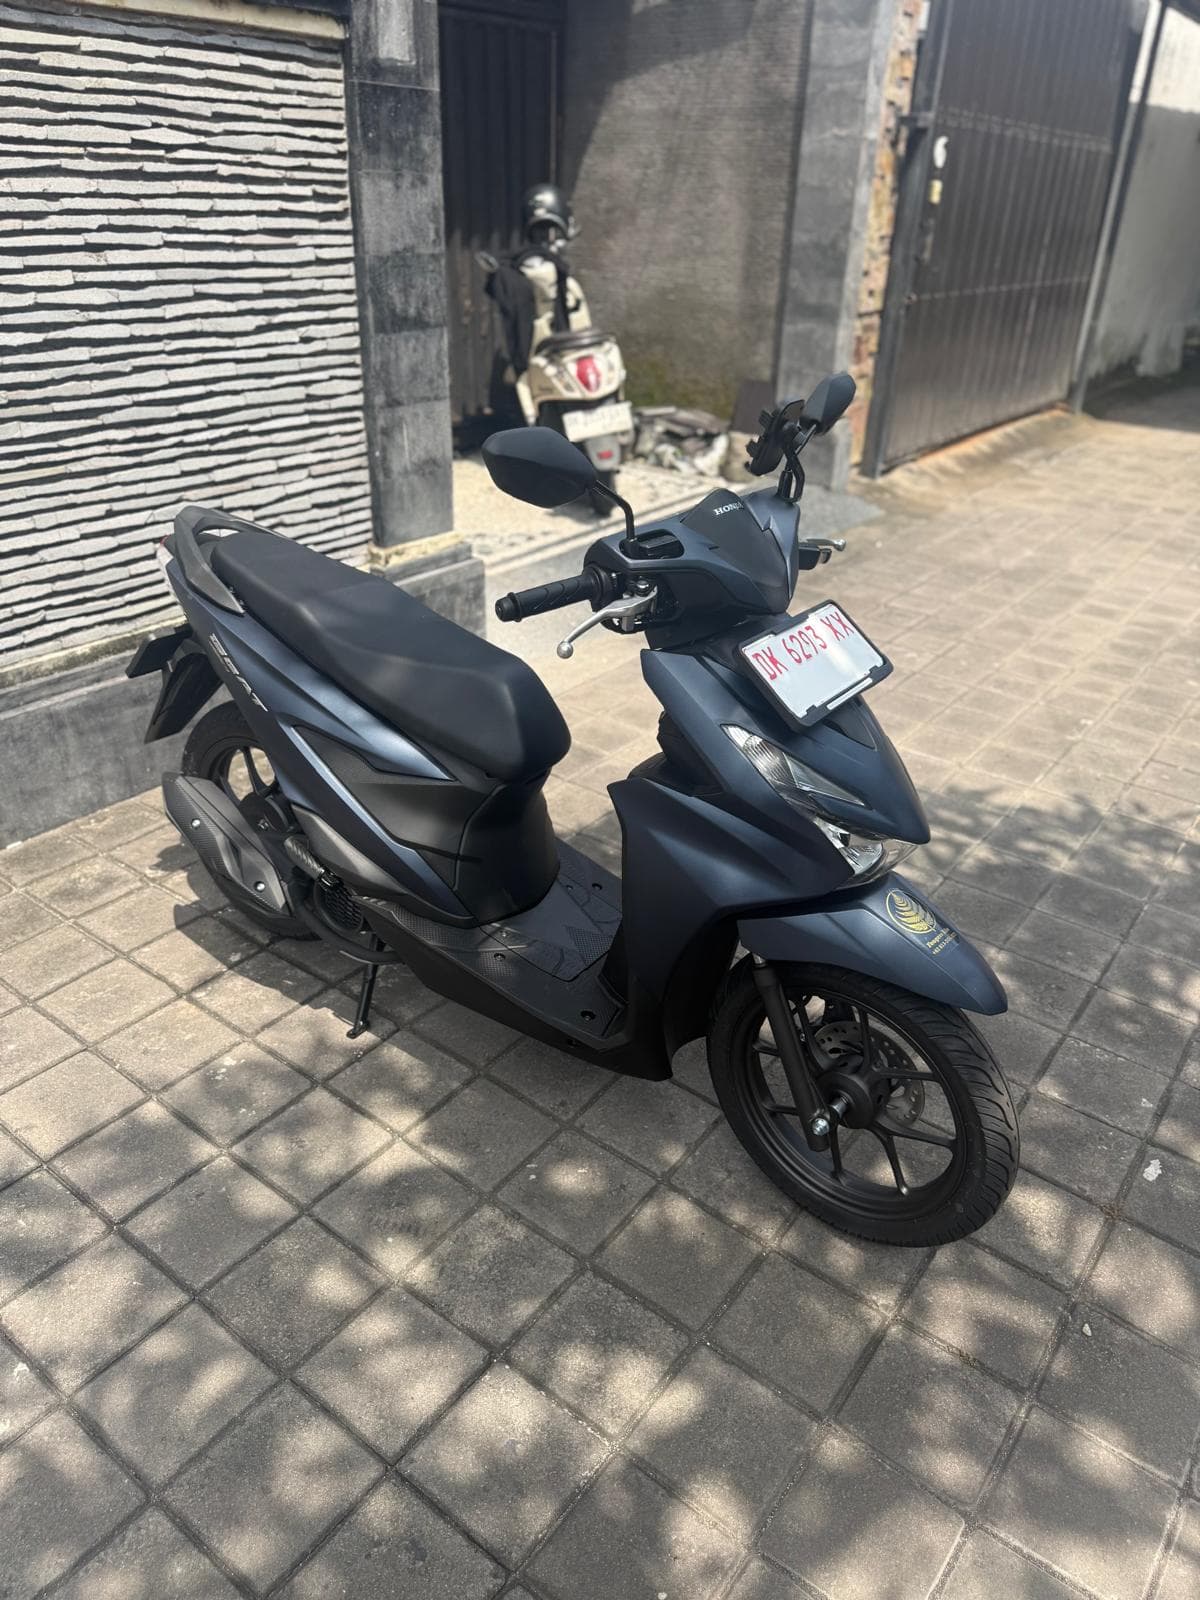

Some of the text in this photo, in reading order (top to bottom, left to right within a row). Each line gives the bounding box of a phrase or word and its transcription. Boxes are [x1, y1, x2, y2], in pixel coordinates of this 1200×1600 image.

[752, 611, 854, 680] DK 6293 XX
